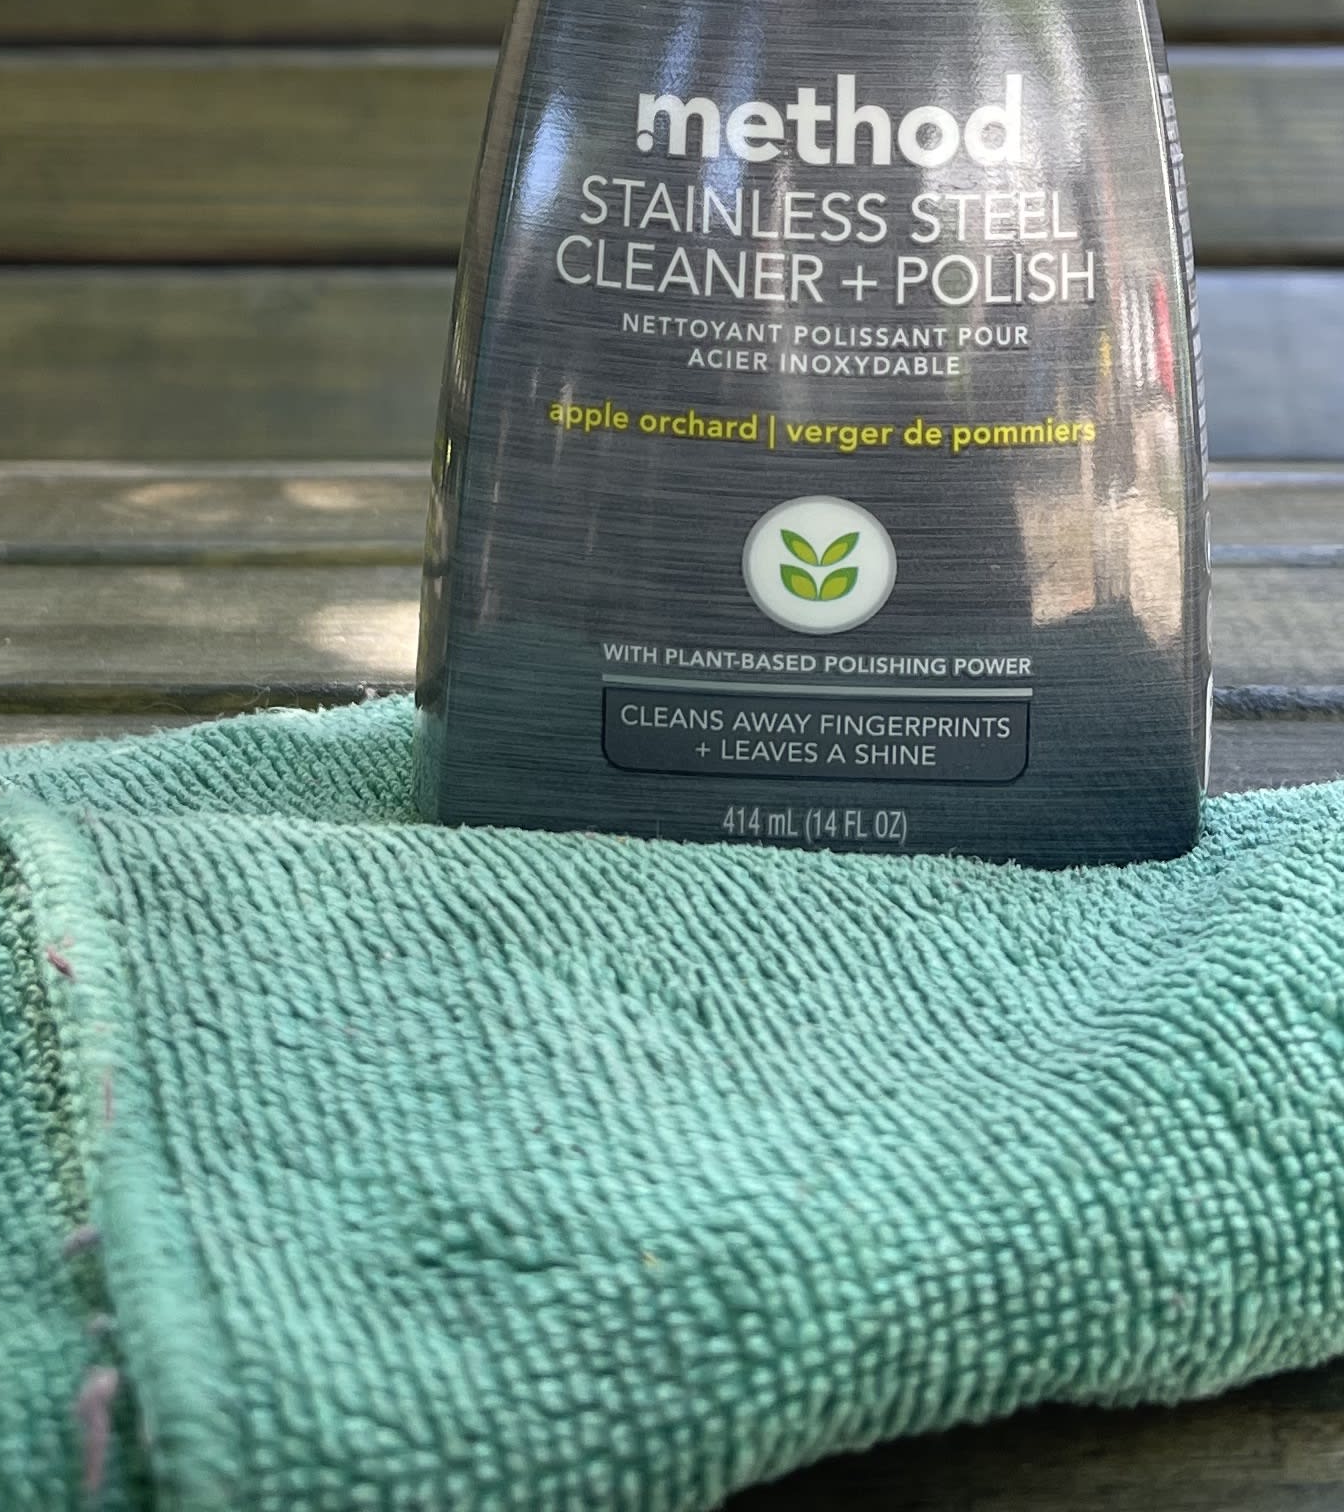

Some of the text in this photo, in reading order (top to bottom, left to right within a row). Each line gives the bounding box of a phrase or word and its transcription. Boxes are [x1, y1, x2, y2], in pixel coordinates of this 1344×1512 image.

[636, 73, 1022, 167] method
[579, 174, 1077, 243] STAINLESS STEEL
[555, 235, 1095, 306] CLEANER + POLISH
[621, 313, 1029, 347] NETTOYANT POLISSANT POUR
[688, 348, 961, 376] ACIER INOXYDABLE
[548, 400, 629, 432] apple
[640, 405, 758, 441] orchard
[786, 422, 893, 452] verger
[903, 419, 942, 447] de
[953, 417, 1096, 452] pommiers
[603, 643, 1031, 676] WITH PLANT-BASED POLISHING POWER
[621, 705, 1010, 739] CLEANS AWAY FINGERPRINTS
[695, 740, 935, 767] + LEAVES A SHINE
[722, 807, 907, 844] 414 mL (14 FL OZ)
